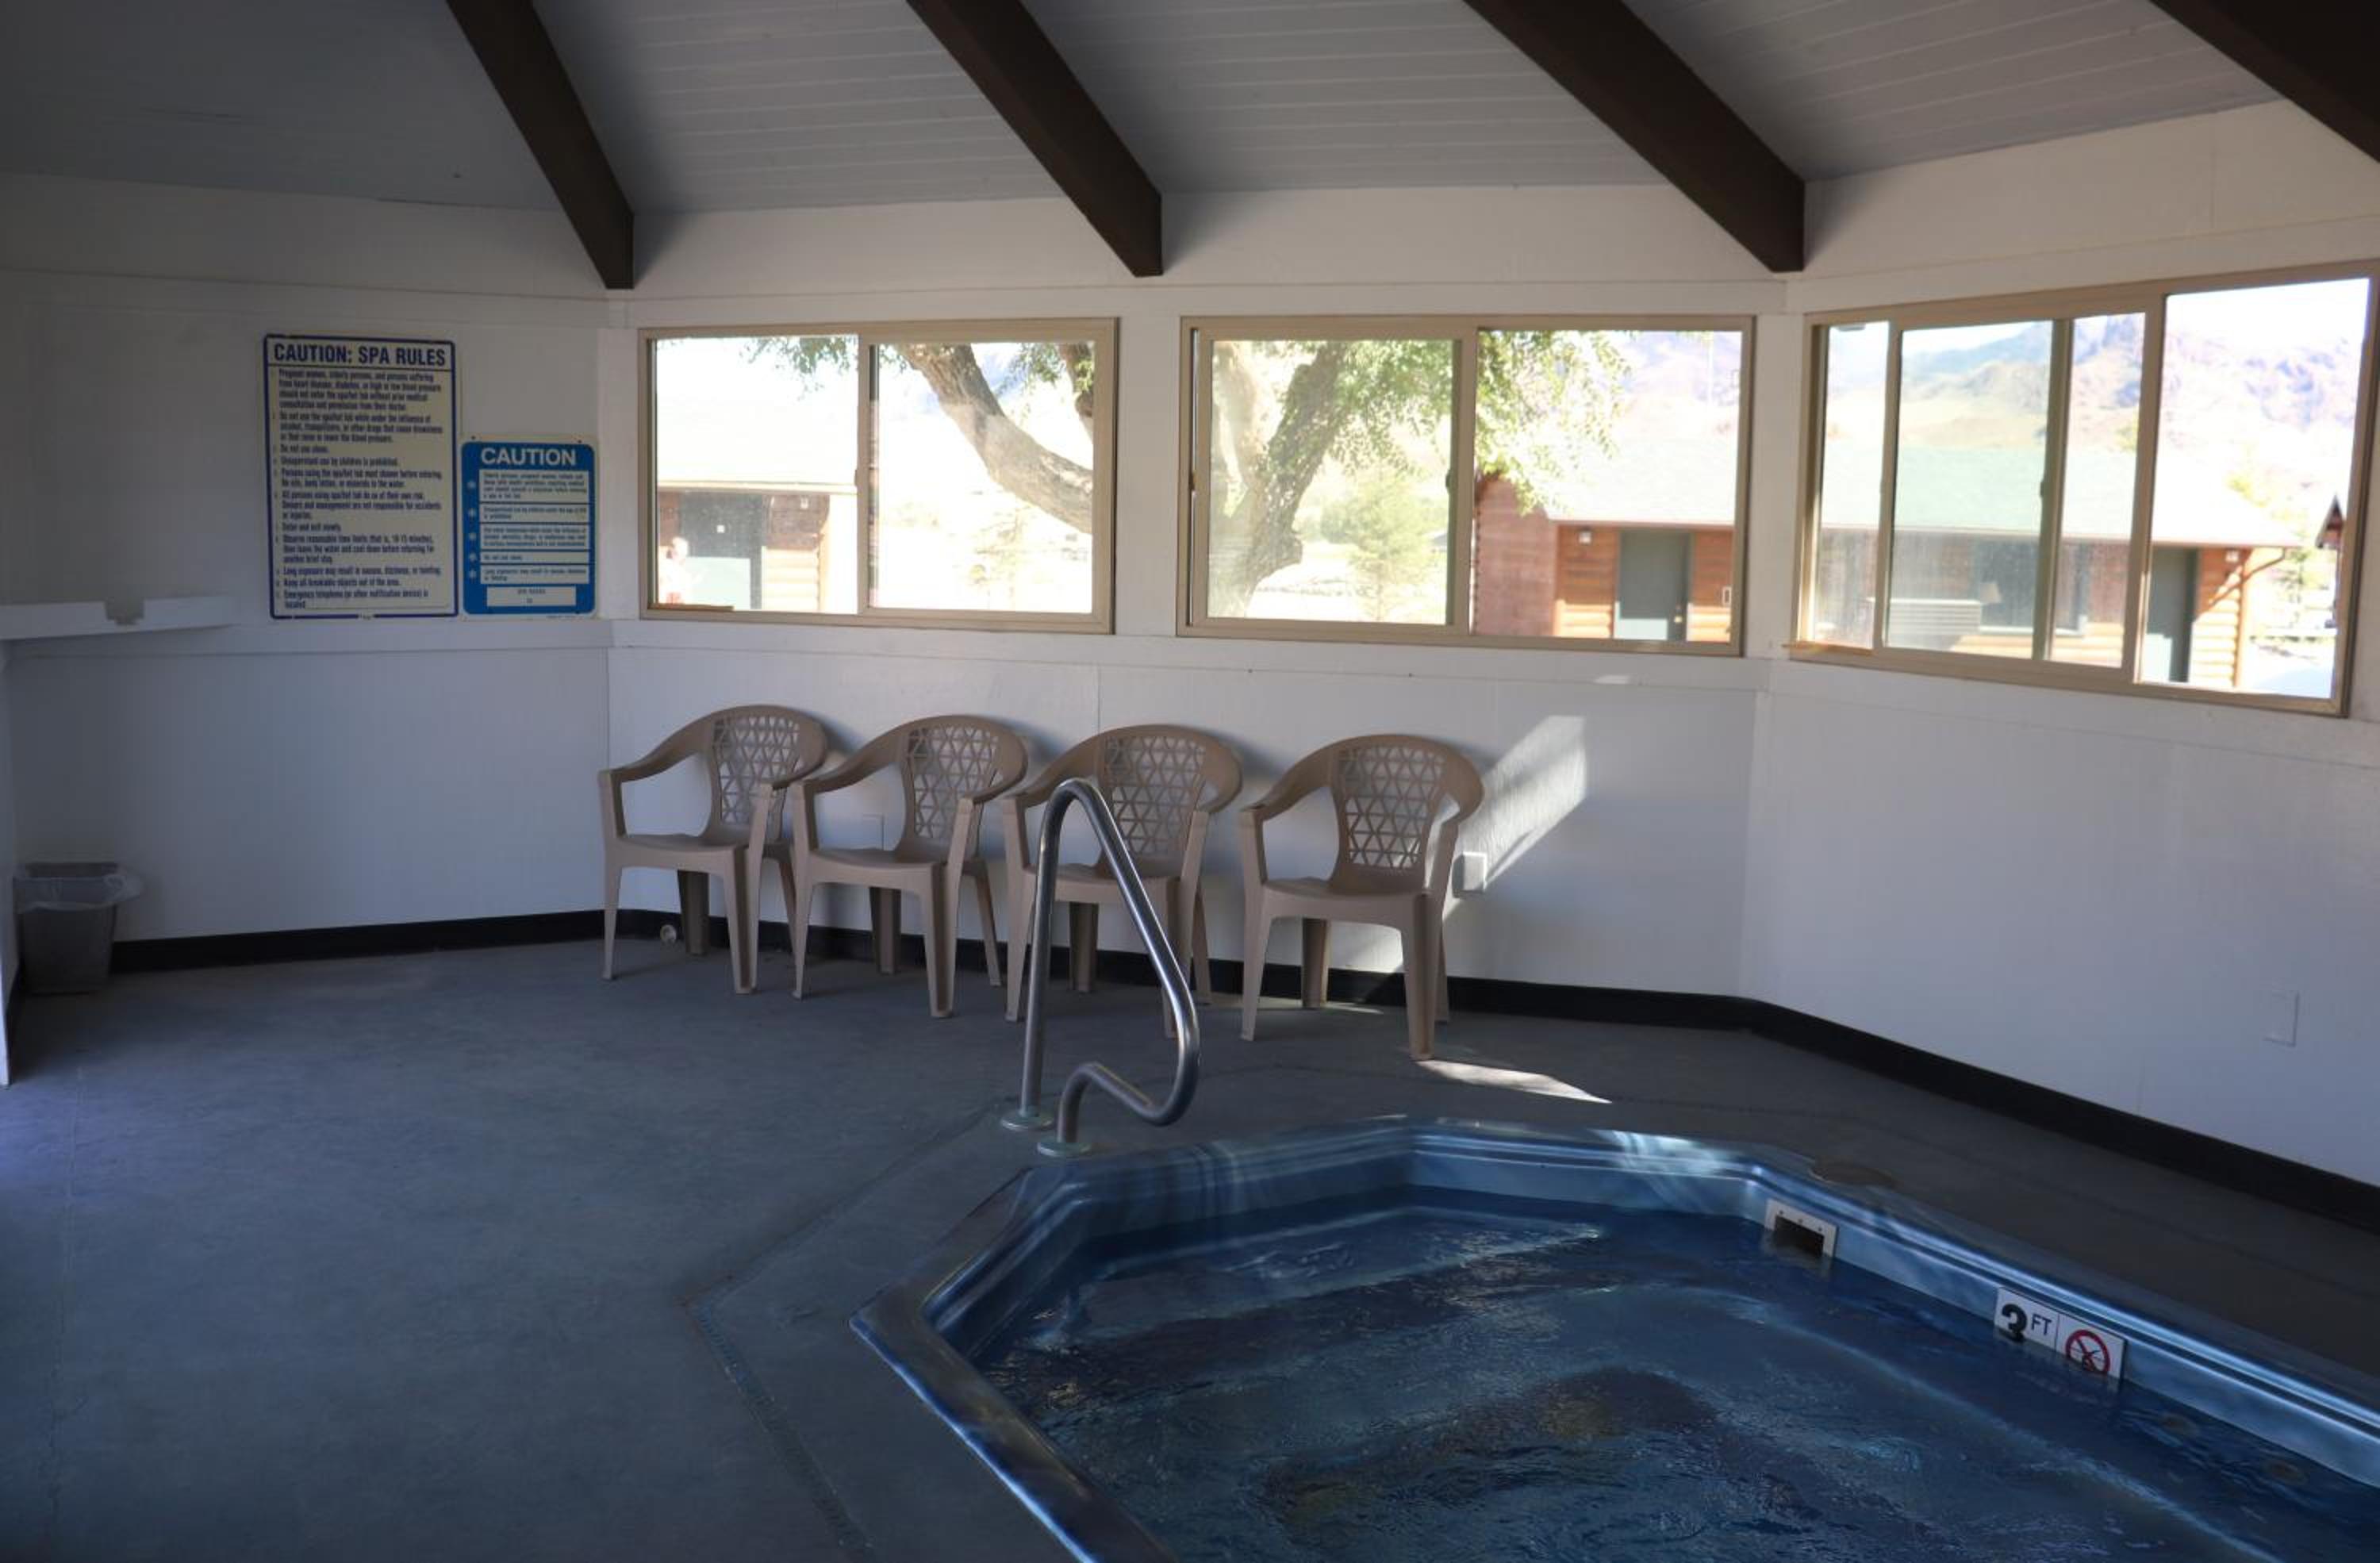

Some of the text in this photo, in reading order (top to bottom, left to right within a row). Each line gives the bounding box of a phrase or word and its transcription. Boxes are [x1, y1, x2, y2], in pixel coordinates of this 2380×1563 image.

[274, 344, 445, 366] CAUTION: SPA RULES
[481, 447, 576, 466] CAUTION
[2002, 1304, 2052, 1342] 3 FT
